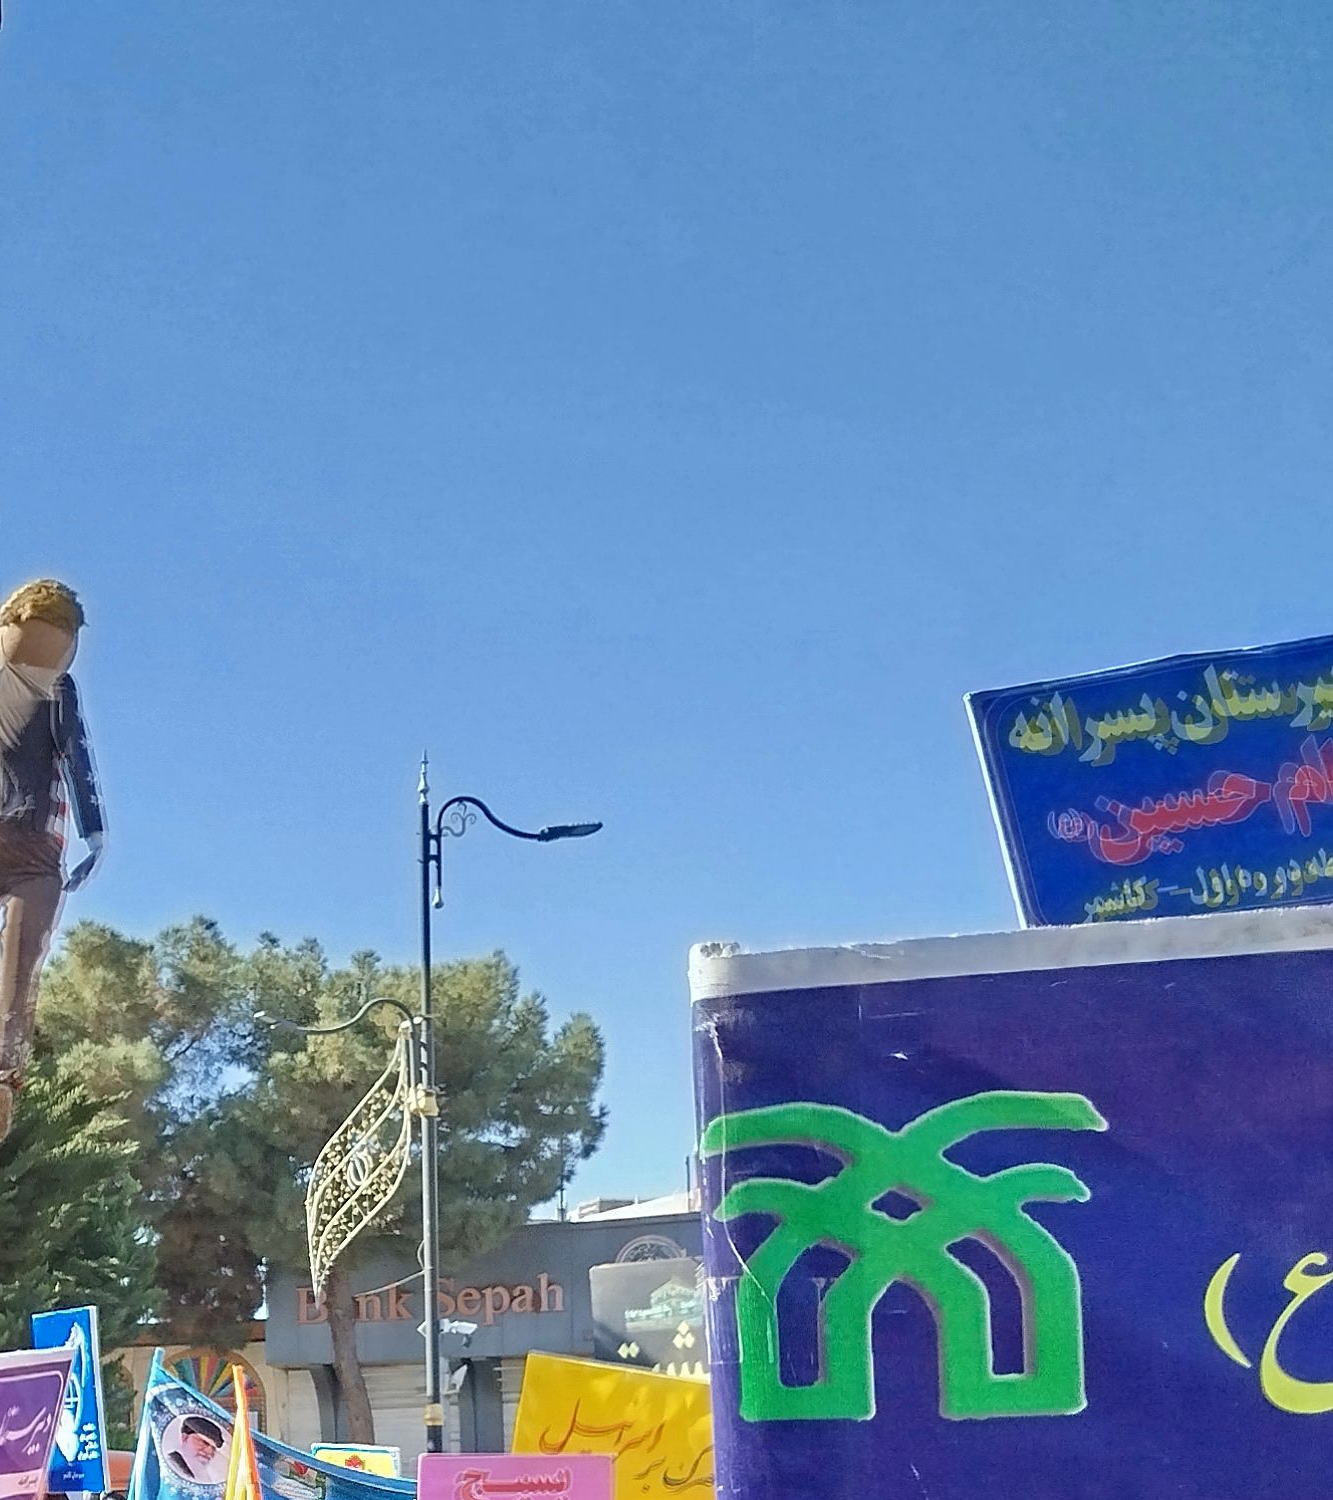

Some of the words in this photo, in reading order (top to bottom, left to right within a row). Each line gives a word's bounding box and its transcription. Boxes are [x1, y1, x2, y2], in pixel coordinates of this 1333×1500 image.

[1008, 690, 1181, 768] پسرانه
[1087, 770, 1271, 867] حسین
[294, 1283, 414, 1327] Bnk
[435, 1272, 565, 1328] Sepah
